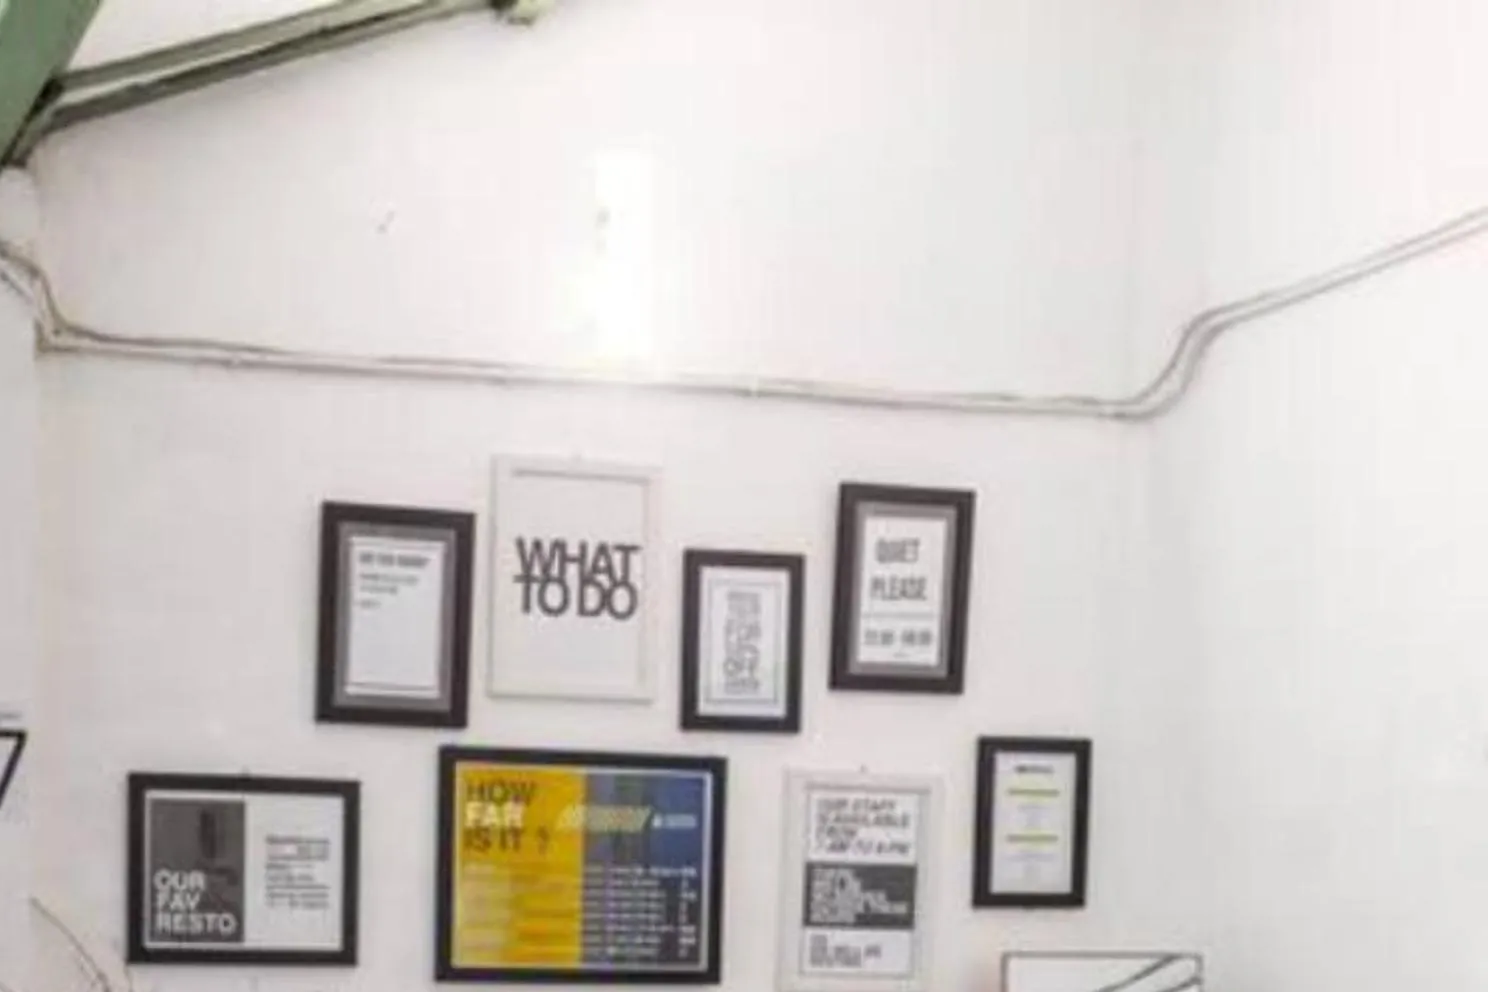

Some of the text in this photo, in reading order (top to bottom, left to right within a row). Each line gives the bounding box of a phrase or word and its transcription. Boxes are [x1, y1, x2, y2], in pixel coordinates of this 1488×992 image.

[515, 537, 641, 578] WHAT
[874, 536, 920, 565] QUIET
[513, 575, 639, 621] TO DO
[870, 576, 927, 602] PLEASE
[465, 781, 537, 804] HOW
[464, 801, 526, 829] FAR
[464, 828, 492, 853] IS
[498, 828, 522, 853] IT
[154, 868, 206, 891] OUR
[157, 891, 200, 911] FAV
[155, 911, 238, 937] RESTO
